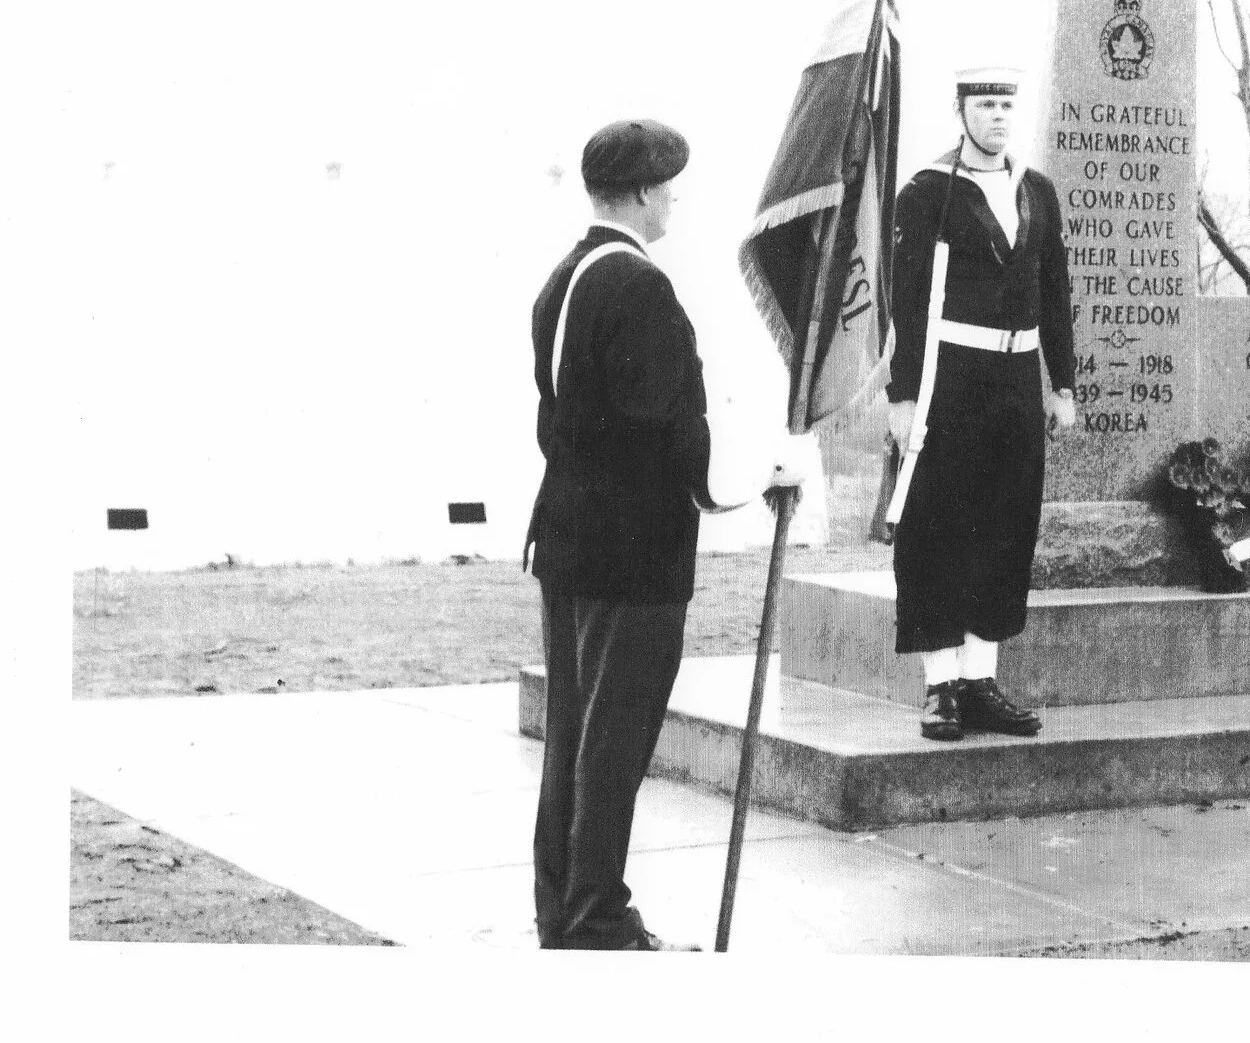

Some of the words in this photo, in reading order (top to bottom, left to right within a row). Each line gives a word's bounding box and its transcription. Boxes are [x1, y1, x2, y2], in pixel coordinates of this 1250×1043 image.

[1061, 102, 1081, 122] IN
[1090, 104, 1188, 127] GRATEFUL
[1056, 131, 1192, 155] REMEMBRANCE
[1083, 160, 1108, 181] OF
[1119, 162, 1161, 183] OUR
[1068, 188, 1177, 211] COMRADES
[1067, 218, 1113, 238] WHO
[1125, 219, 1175, 240] GAVE
[1130, 249, 1181, 268] LIVES
[1083, 276, 1118, 296] THE
[1126, 276, 1184, 297] CAUSE
[1092, 305, 1181, 325] FREEDOM
[1077, 355, 1097, 375] 14
[1139, 355, 1174, 375] 1918
[1077, 384, 1101, 404] 39
[1130, 384, 1173, 404] 1945
[1084, 412, 1148, 433] KOREA
